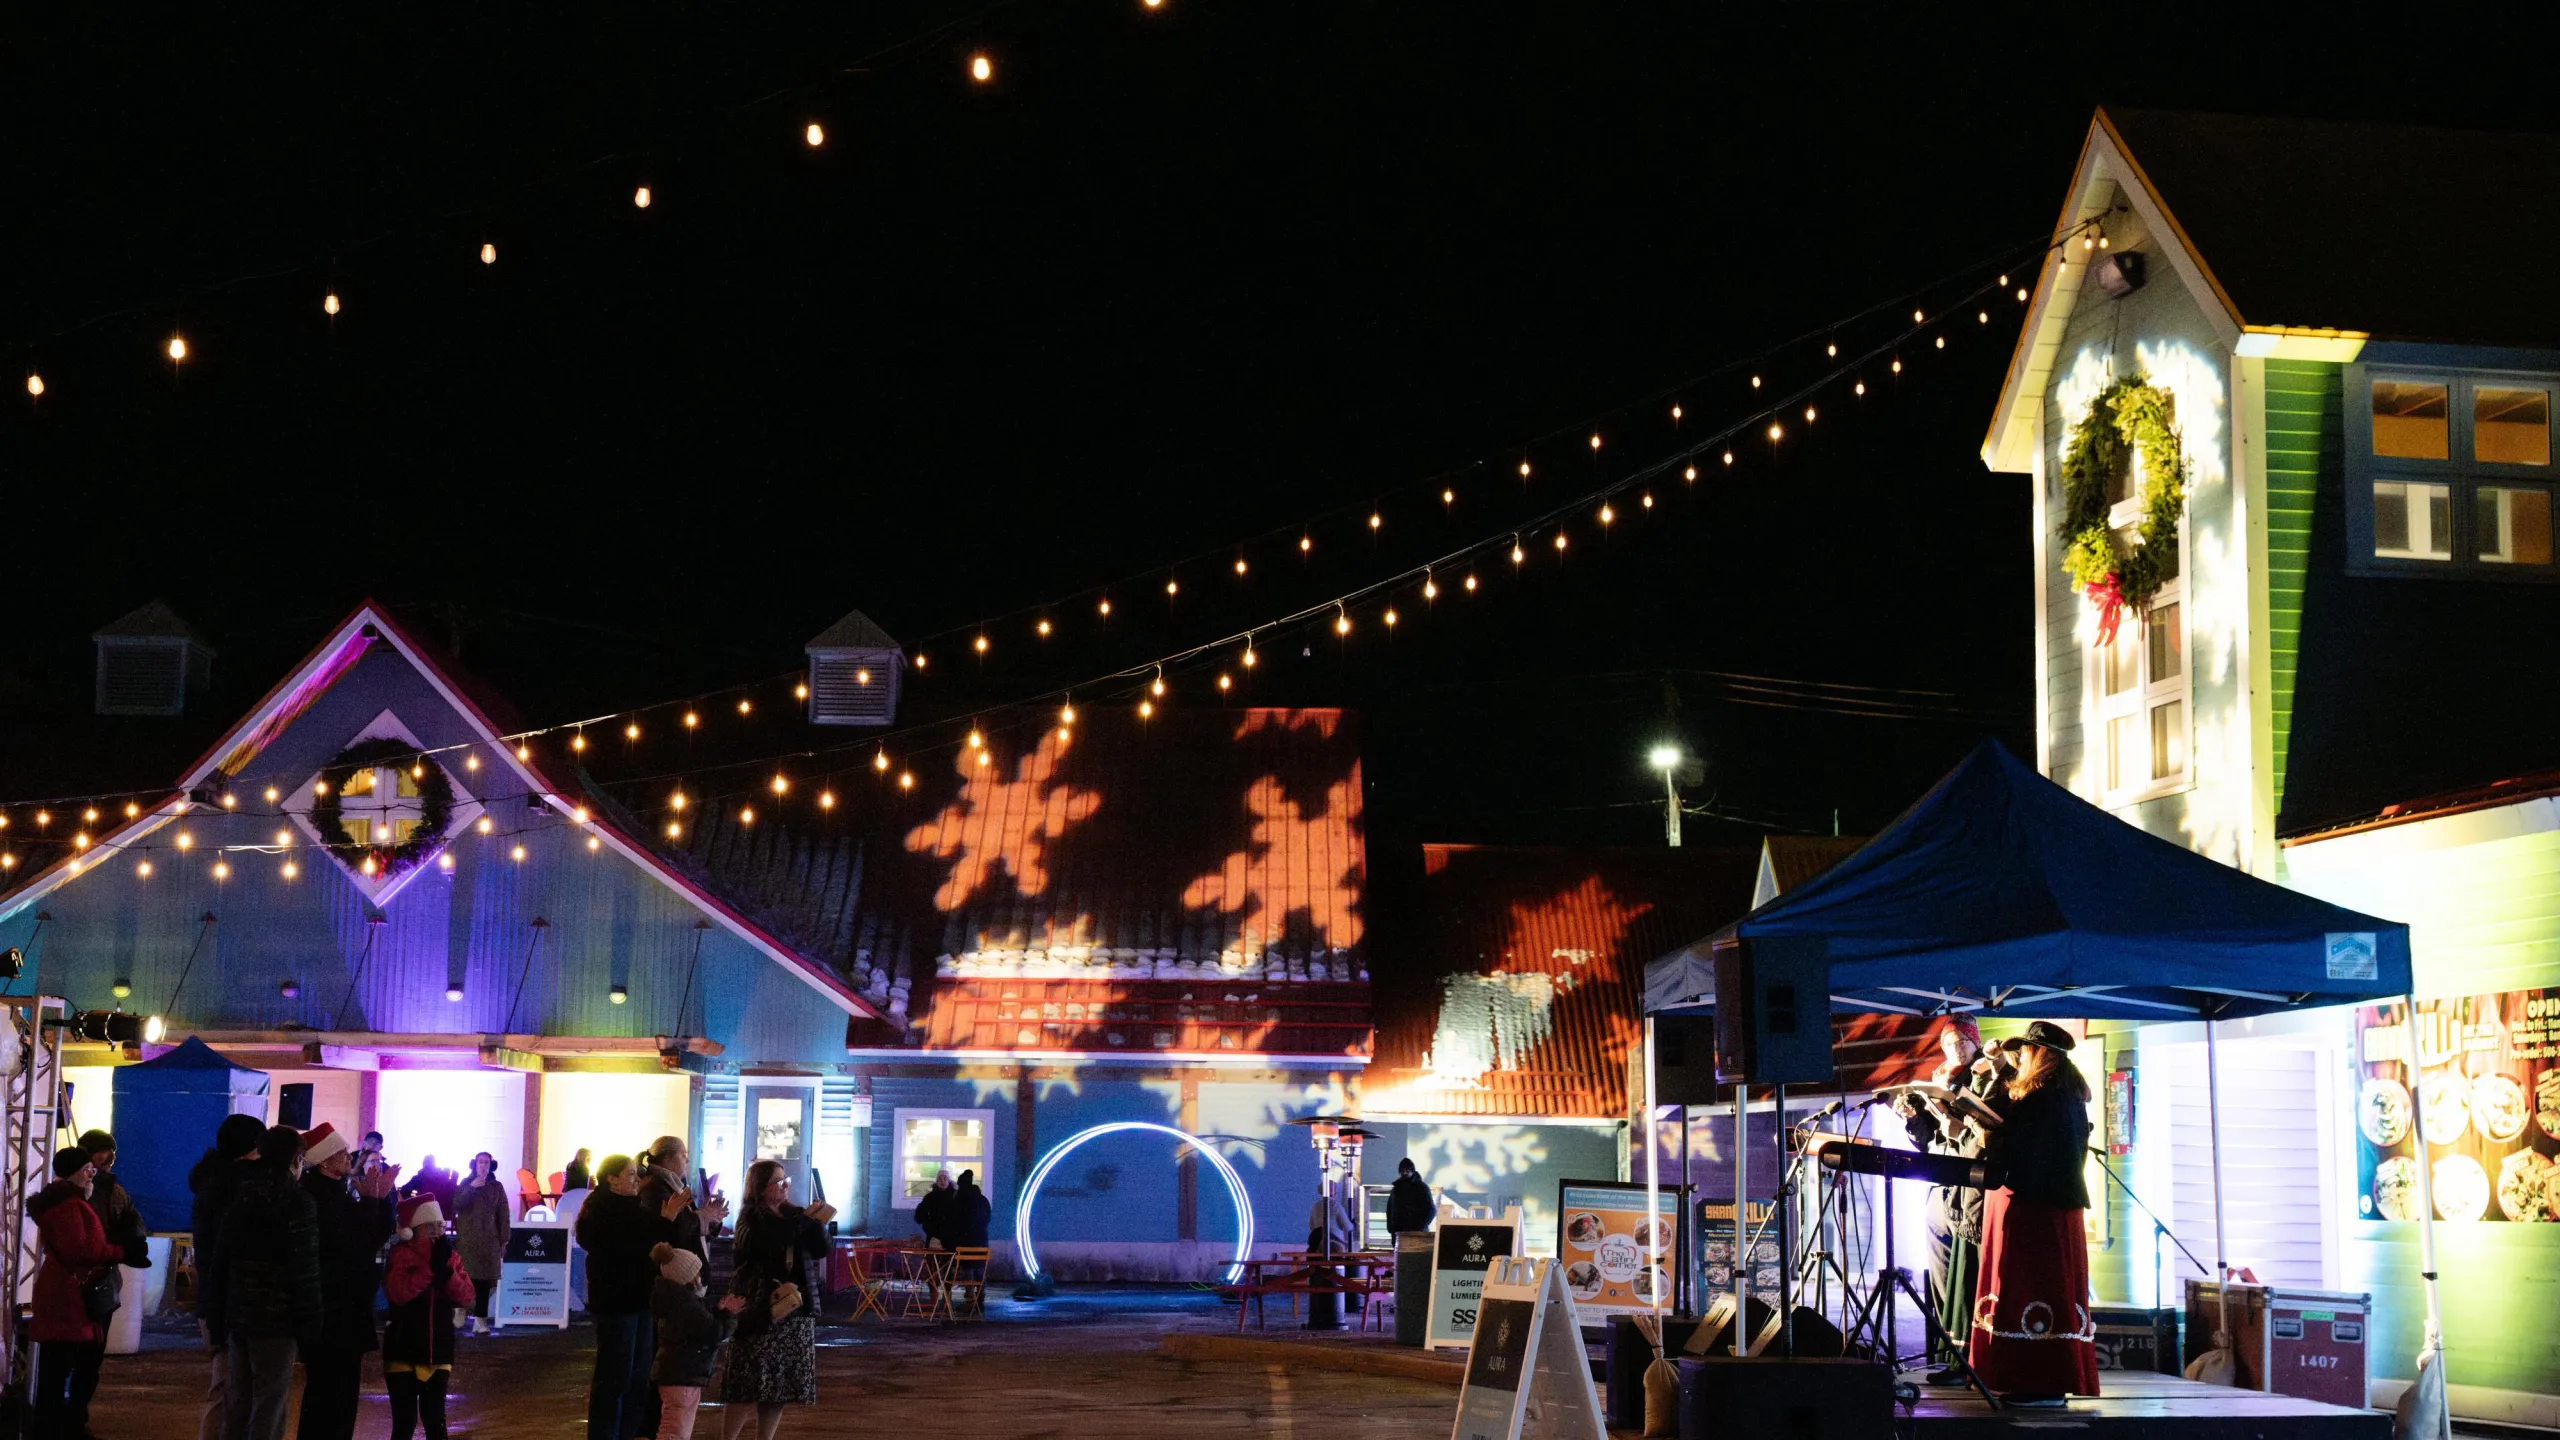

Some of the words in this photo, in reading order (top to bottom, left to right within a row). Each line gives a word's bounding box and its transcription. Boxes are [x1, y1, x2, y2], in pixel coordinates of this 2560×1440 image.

[1604, 1249, 1625, 1258] The
[1462, 1254, 1487, 1263] AURA
[1603, 1255, 1634, 1263] Latin
[1600, 1261, 1638, 1269] corner
[1451, 1291, 1482, 1300] LUMIÈR
[1487, 1355, 1506, 1372] AURA
[2301, 1354, 2339, 1369] 1407
